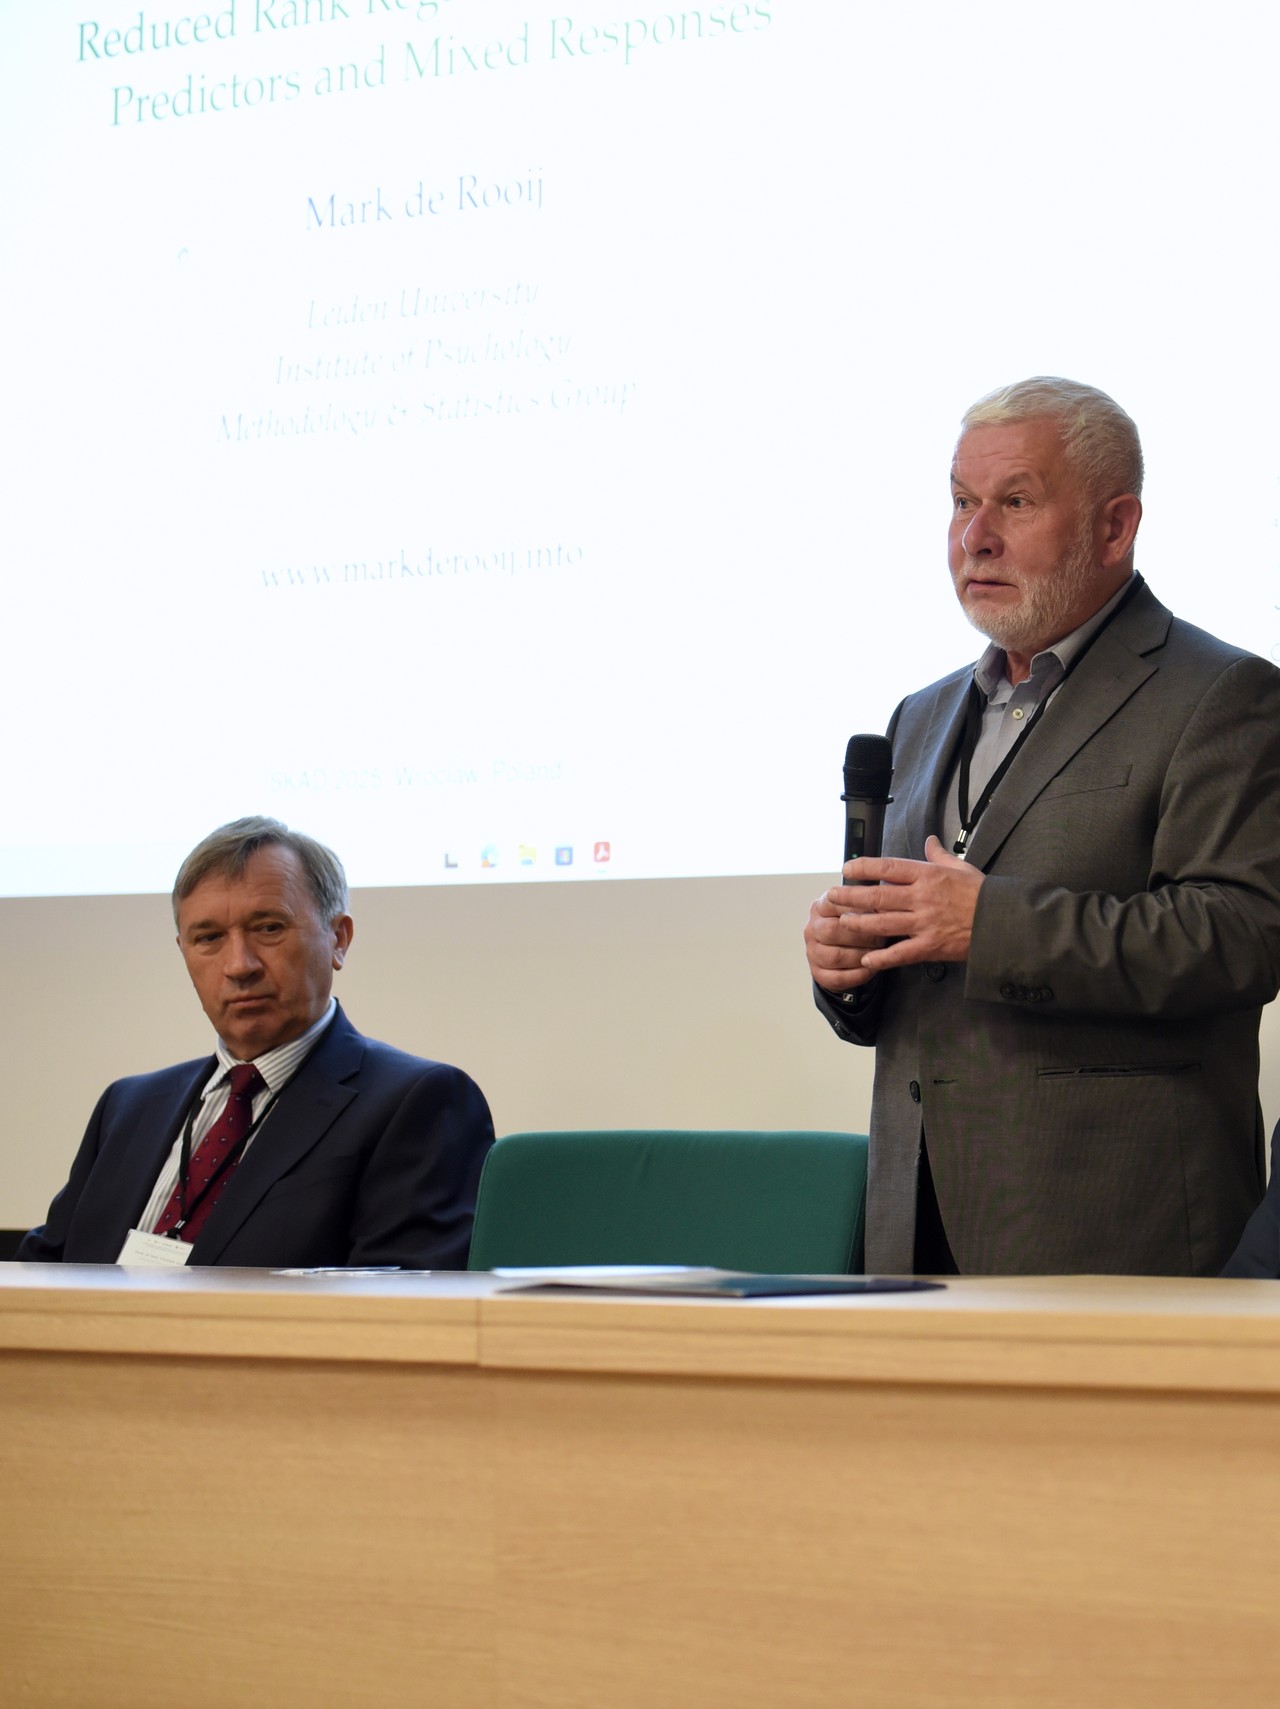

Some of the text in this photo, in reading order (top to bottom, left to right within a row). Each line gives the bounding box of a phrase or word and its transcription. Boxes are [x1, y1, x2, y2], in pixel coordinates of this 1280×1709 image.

[76, 11, 237, 63] Reduced
[111, 0, 772, 127] Predictors and Mixed Responses
[305, 168, 544, 231] Mark de Rooij
[275, 352, 382, 385] Institute
[215, 401, 379, 445] Methodology
[549, 377, 638, 415] Group
[260, 543, 585, 588] www.markderooij.info
